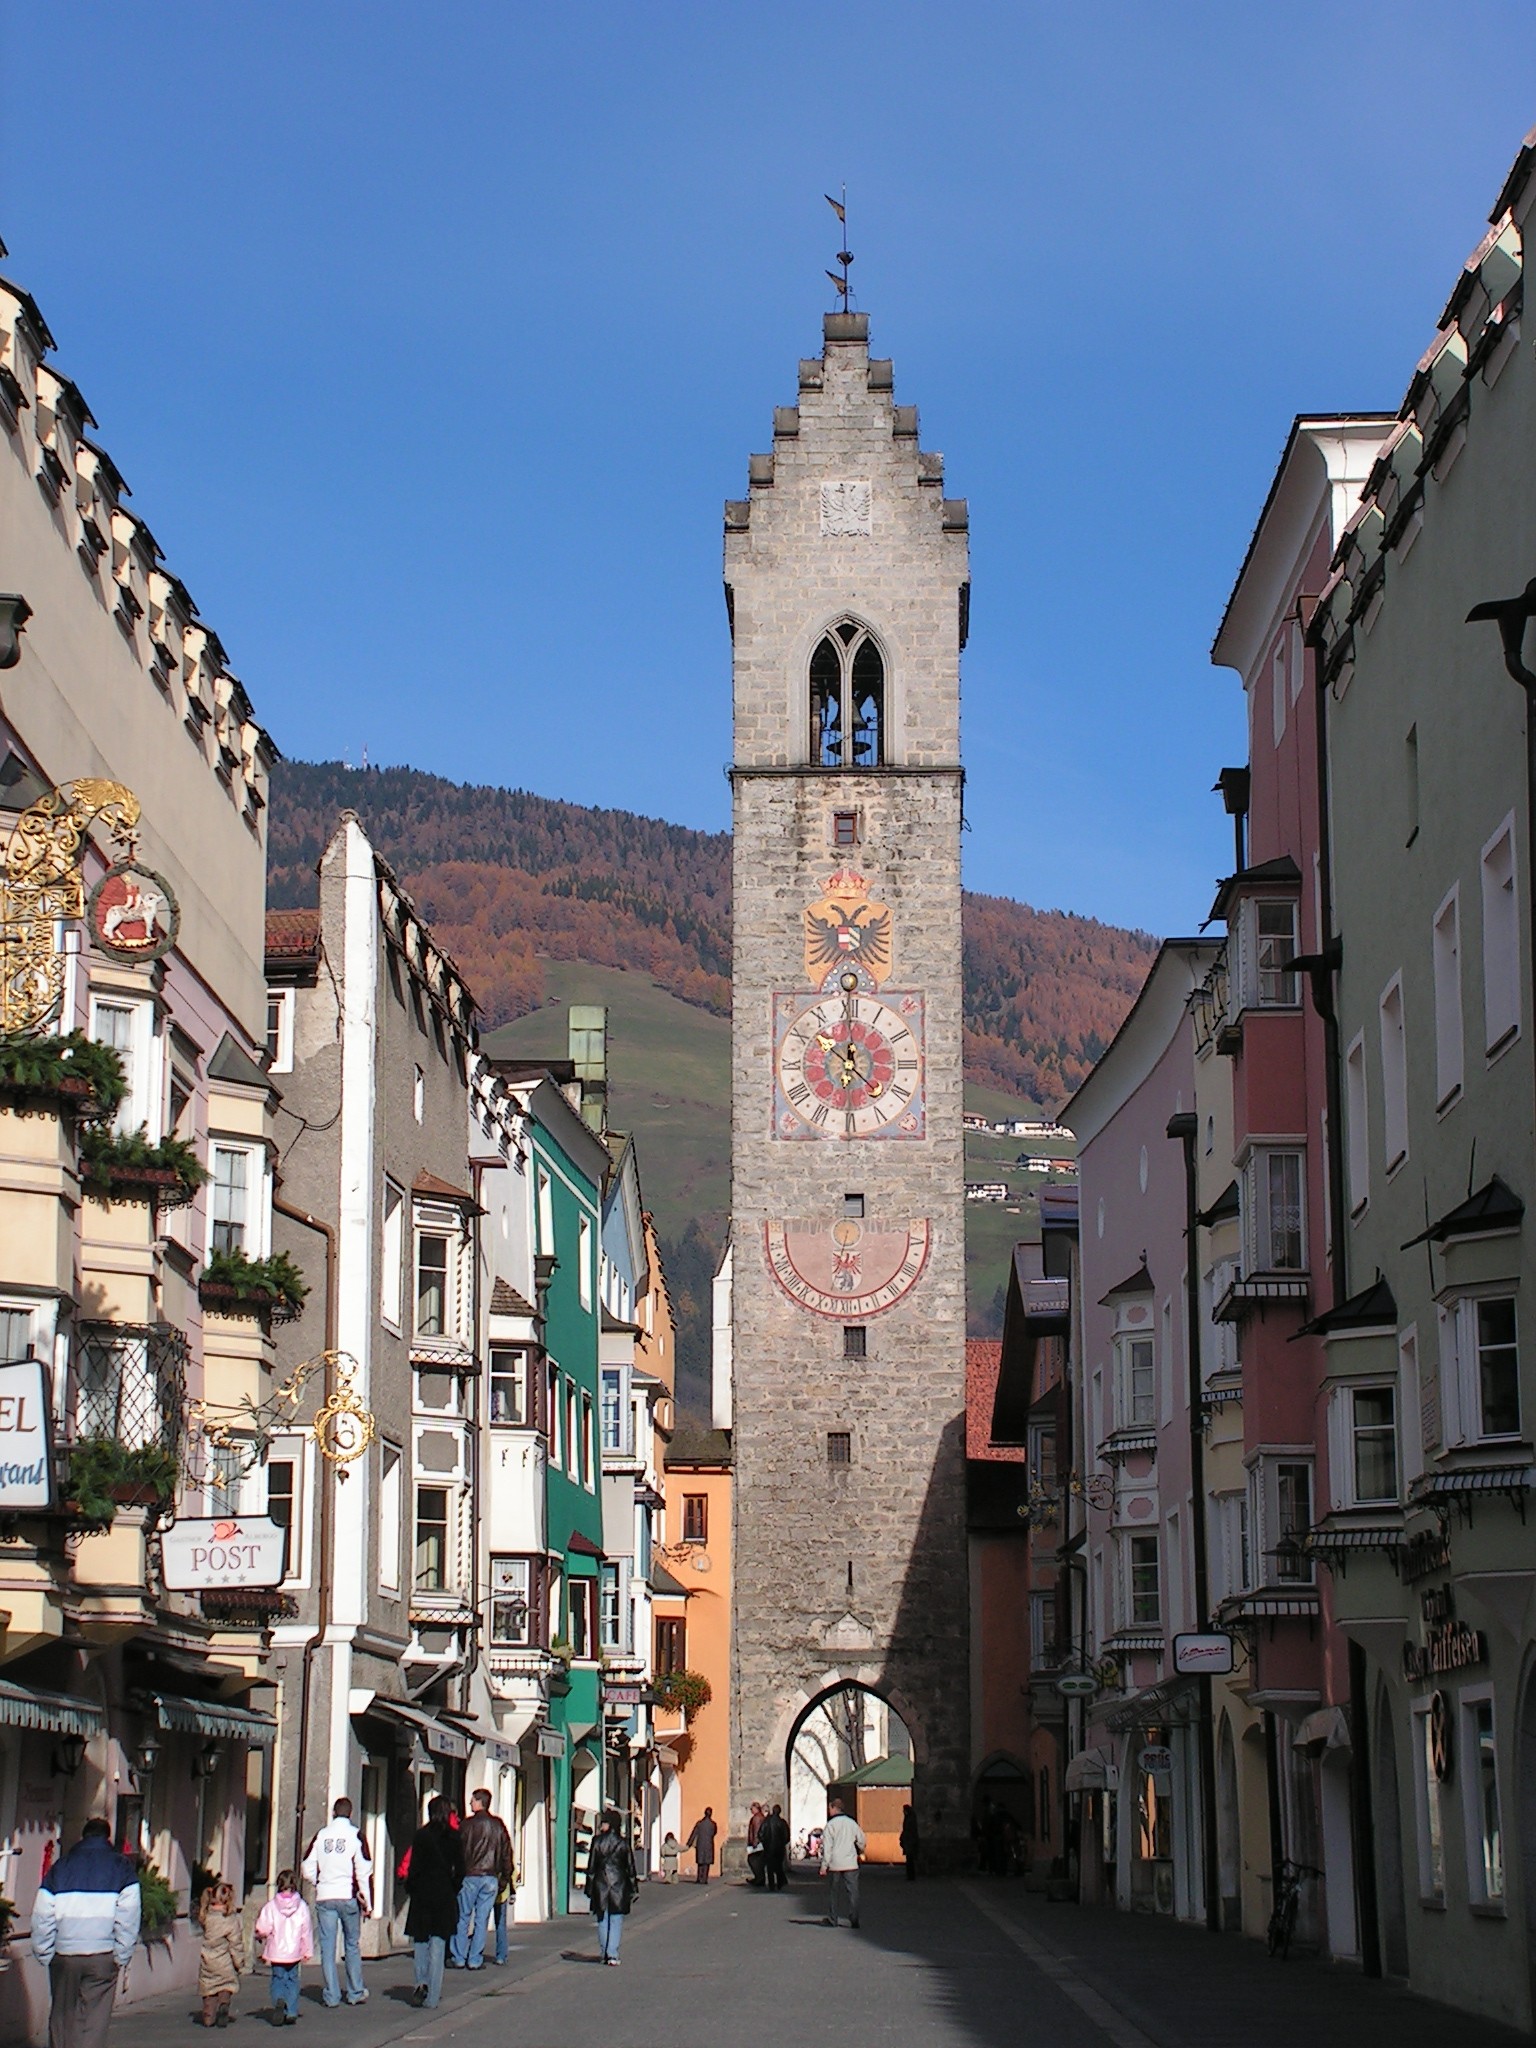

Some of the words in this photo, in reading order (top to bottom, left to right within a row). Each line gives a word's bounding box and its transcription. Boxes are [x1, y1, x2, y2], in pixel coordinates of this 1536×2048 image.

[810, 1006, 827, 1028] XI
[790, 1028, 809, 1045] X
[890, 1029, 910, 1044] II
[782, 1058, 801, 1071] IX
[897, 1059, 917, 1070] III
[873, 1106, 888, 1124] V
[190, 1545, 261, 1572] POST
[323, 1838, 346, 1854] 55
